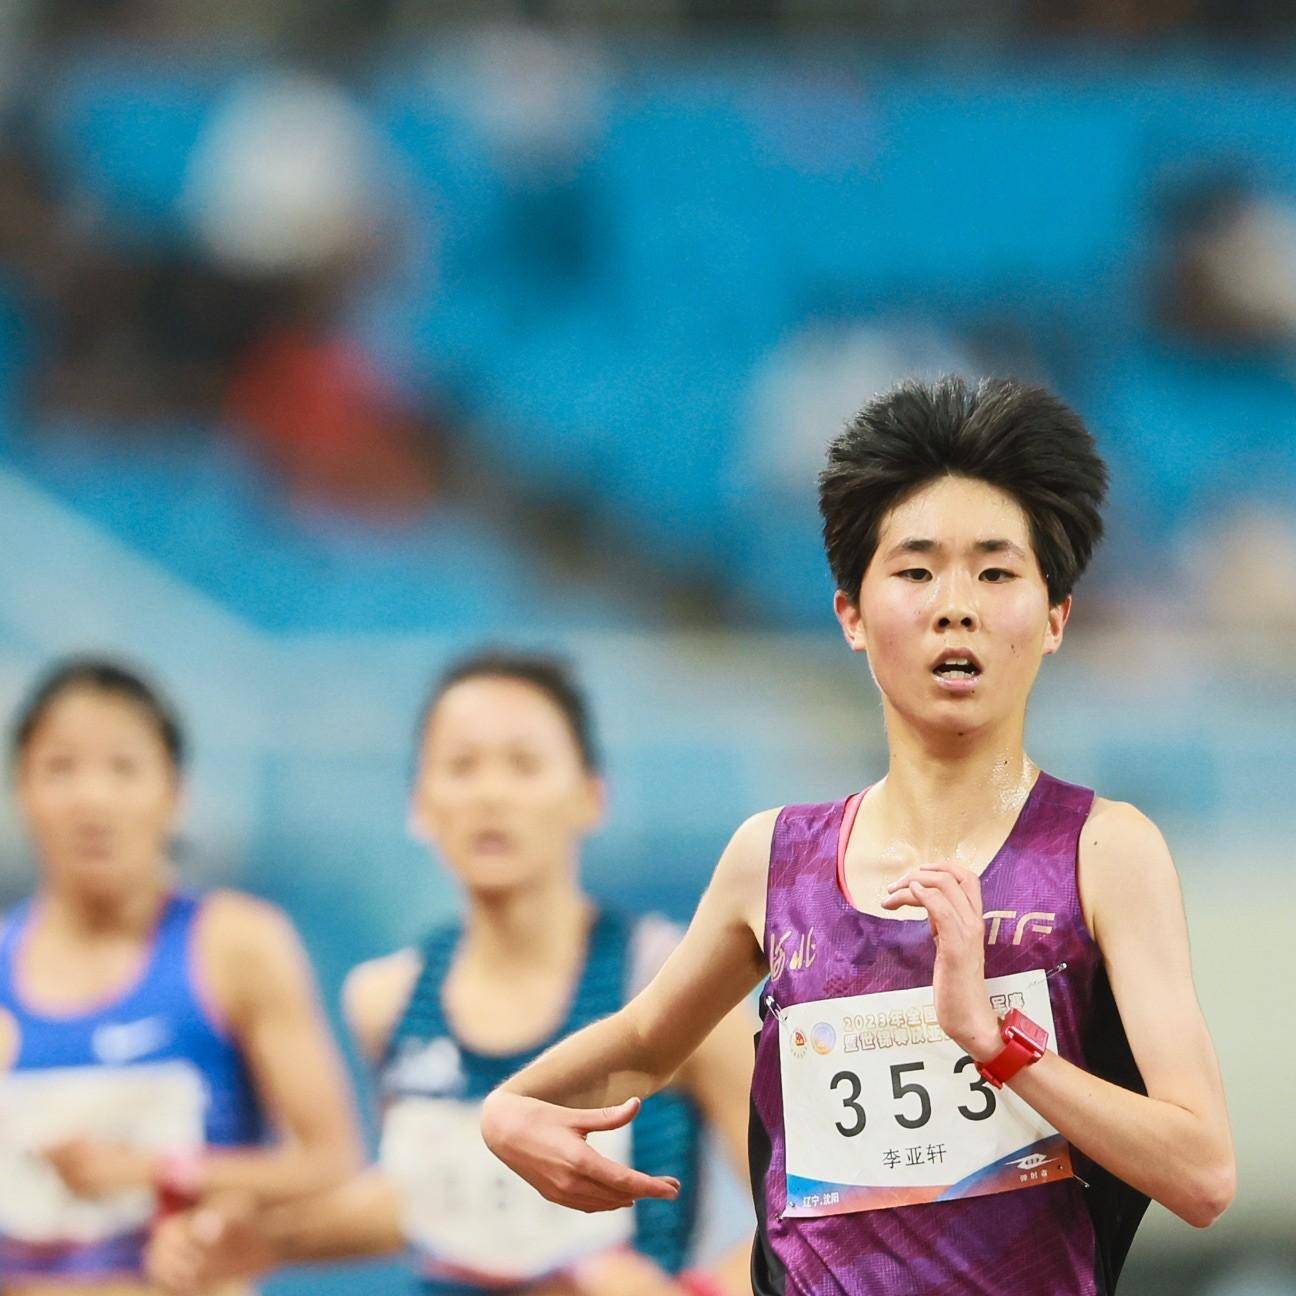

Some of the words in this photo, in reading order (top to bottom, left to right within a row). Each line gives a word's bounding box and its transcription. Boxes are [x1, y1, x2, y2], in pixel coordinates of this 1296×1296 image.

[829, 1055, 997, 1138] 353
[882, 1143, 947, 1169] 李亚轩
